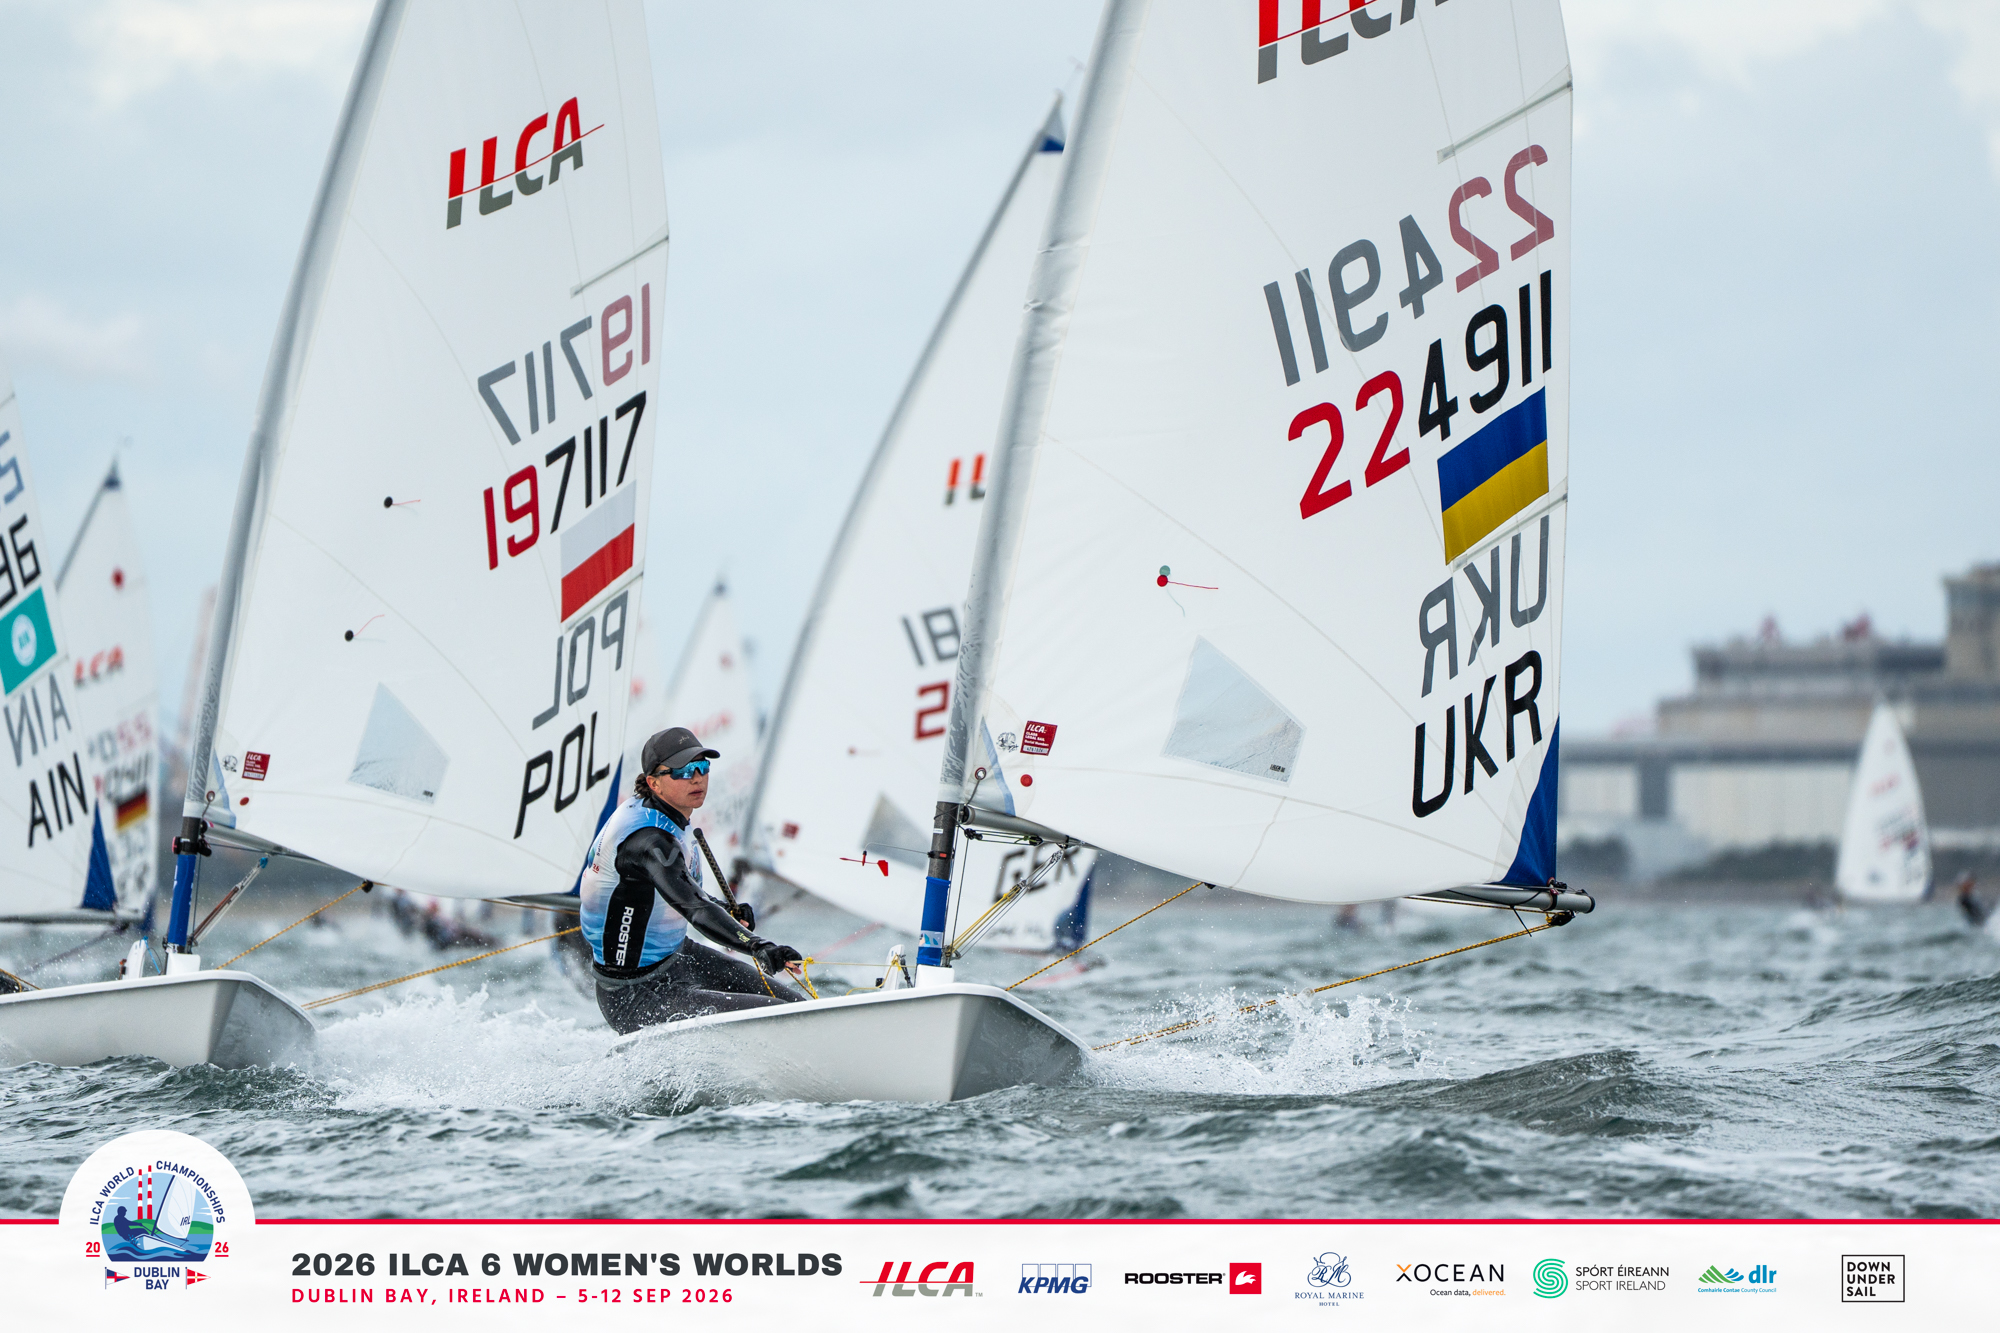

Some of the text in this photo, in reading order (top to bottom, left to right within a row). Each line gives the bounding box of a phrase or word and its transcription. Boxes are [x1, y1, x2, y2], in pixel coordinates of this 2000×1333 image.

[1257, 0, 1450, 84] IL
[446, 96, 584, 230] ILCA
[1288, 269, 1553, 520] 224911
[482, 390, 648, 571] 197117
[28, 751, 89, 849] AIN
[513, 710, 611, 840] POL
[1412, 649, 1543, 819] UKR
